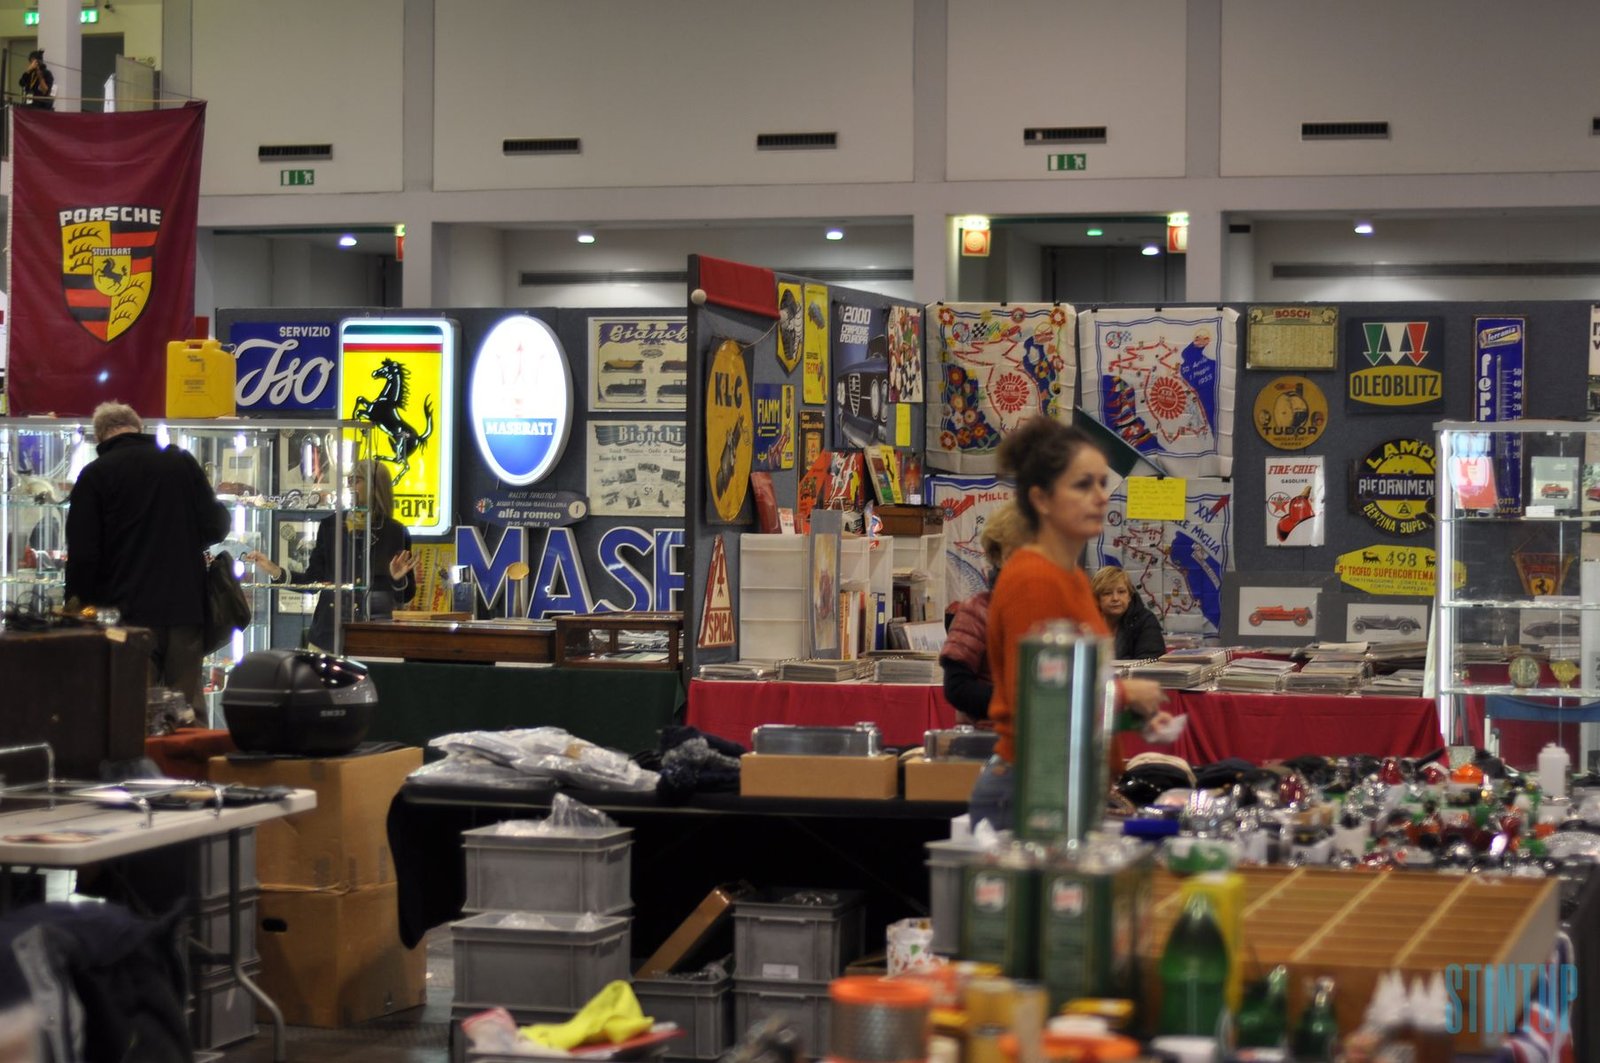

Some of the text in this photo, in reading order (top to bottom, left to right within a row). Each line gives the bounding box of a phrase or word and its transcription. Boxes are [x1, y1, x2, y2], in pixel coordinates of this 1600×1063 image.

[59, 206, 161, 226] PORSCHE
[843, 306, 871, 325] 2000
[1275, 310, 1311, 318] BOSCH
[279, 326, 331, 337] SERVIZIO
[234, 338, 335, 406] Iso
[1352, 375, 1439, 396] OLEOBLITZ
[485, 421, 554, 436] MASERATI
[619, 426, 682, 443] Bianchi
[1262, 427, 1318, 435] TUDOR
[978, 492, 1009, 503] MILLE
[498, 508, 561, 519] alfa romeo
[1363, 502, 1396, 532] BENZINA
[1190, 525, 1220, 555] MIGLIA
[1386, 551, 1417, 567] 498
[1349, 566, 1371, 576] TROFEO
[708, 611, 733, 643] SPICA
